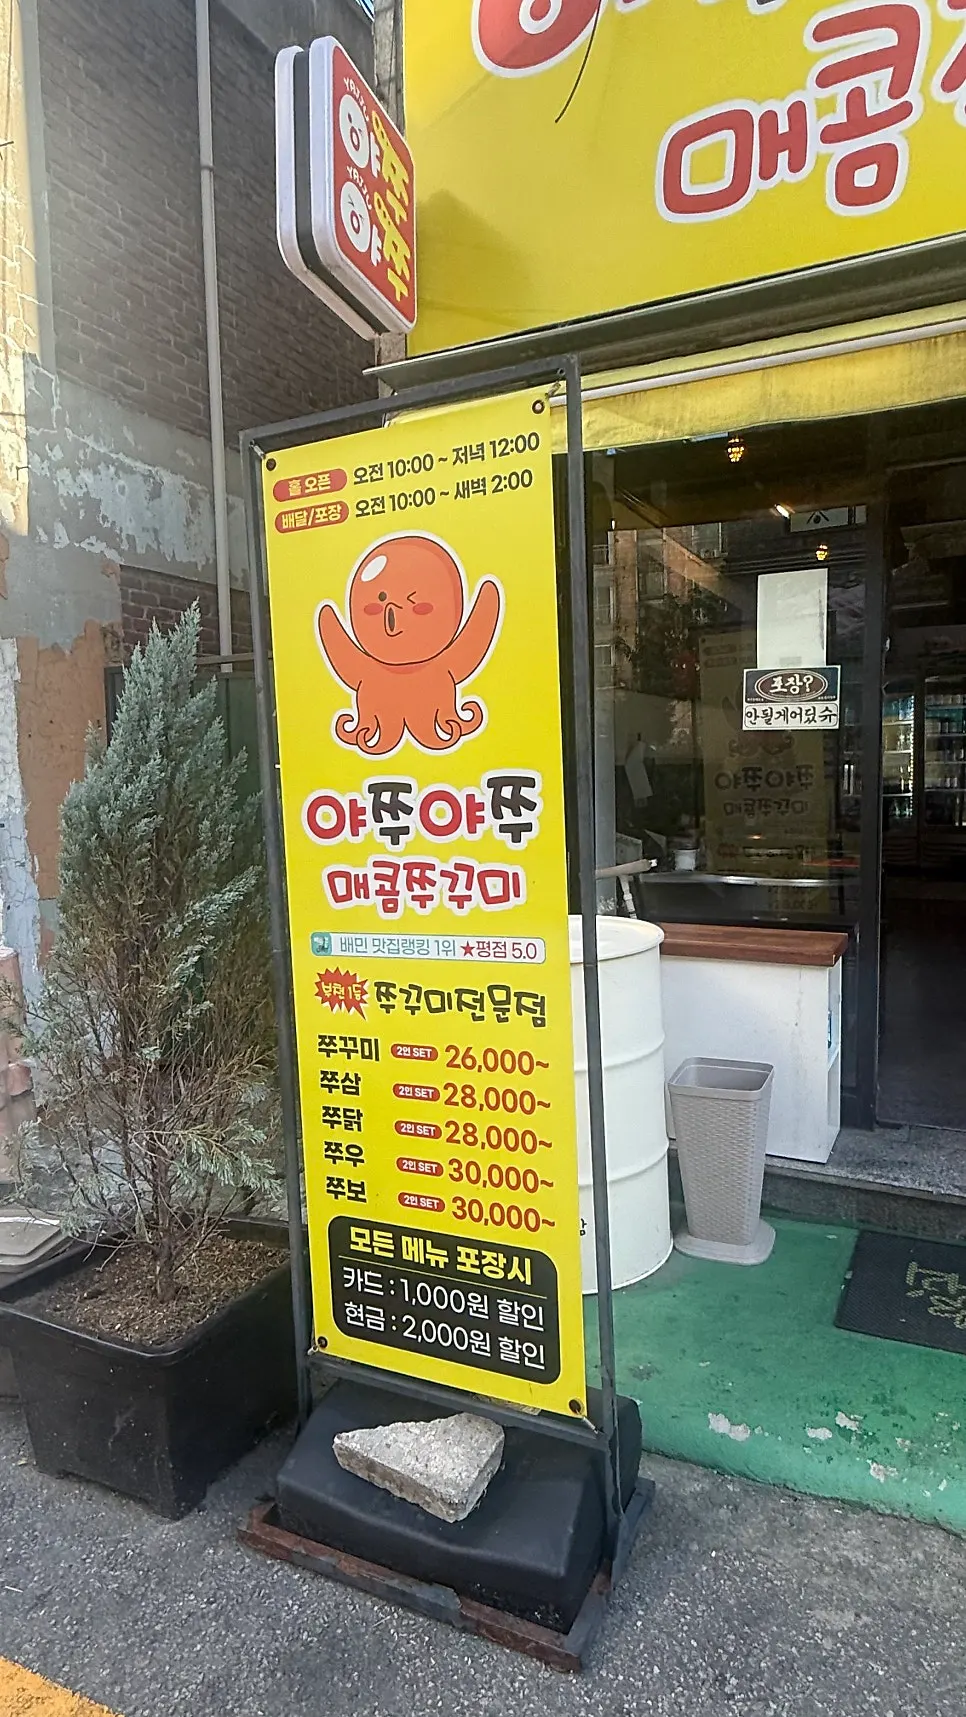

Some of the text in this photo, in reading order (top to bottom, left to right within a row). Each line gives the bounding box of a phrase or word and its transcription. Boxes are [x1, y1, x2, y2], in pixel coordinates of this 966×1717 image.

[663, 3, 966, 215] 매콤
[353, 463, 384, 485] 오전
[388, 453, 434, 479] 10:00
[453, 445, 485, 467] 저녁
[490, 431, 540, 457] 12:00
[287, 475, 331, 497] 홀 오픈
[355, 497, 386, 518] 오전
[390, 487, 436, 512] 10:00
[454, 477, 487, 501] 새벽
[491, 469, 533, 494] 2:00
[281, 504, 342, 529] 배달/포장
[769, 673, 814, 694] 포장?
[306, 775, 537, 846] 야쭈야쭈
[327, 861, 520, 913] 매콤쭈꾸미
[340, 936, 367, 953] 배민
[372, 938, 430, 956] 맛집랭킹
[434, 939, 456, 957] 1위
[512, 942, 537, 960] 5.0
[374, 981, 546, 1027] 쭈꾸미전문점
[318, 1035, 549, 1076] 쭈꾸미 2인 SET 26,000~
[320, 1070, 550, 1115] 쭈삼 2인 SET 28,000~
[322, 1106, 552, 1154] 쭈닭 2인 SET 28,000~
[324, 1141, 554, 1193] 쭈우 2인 SET 30,000~
[326, 1176, 555, 1232] 쭈보 2인 SET 30,000~
[350, 1226, 532, 1286] 모든 메뉴 포장시
[343, 1266, 384, 1296] 카드
[400, 1278, 489, 1320] 1,000원
[497, 1298, 544, 1332] 할인
[344, 1302, 385, 1332] 현금
[402, 1314, 491, 1357] 2,000원
[498, 1336, 545, 1370] 할인
